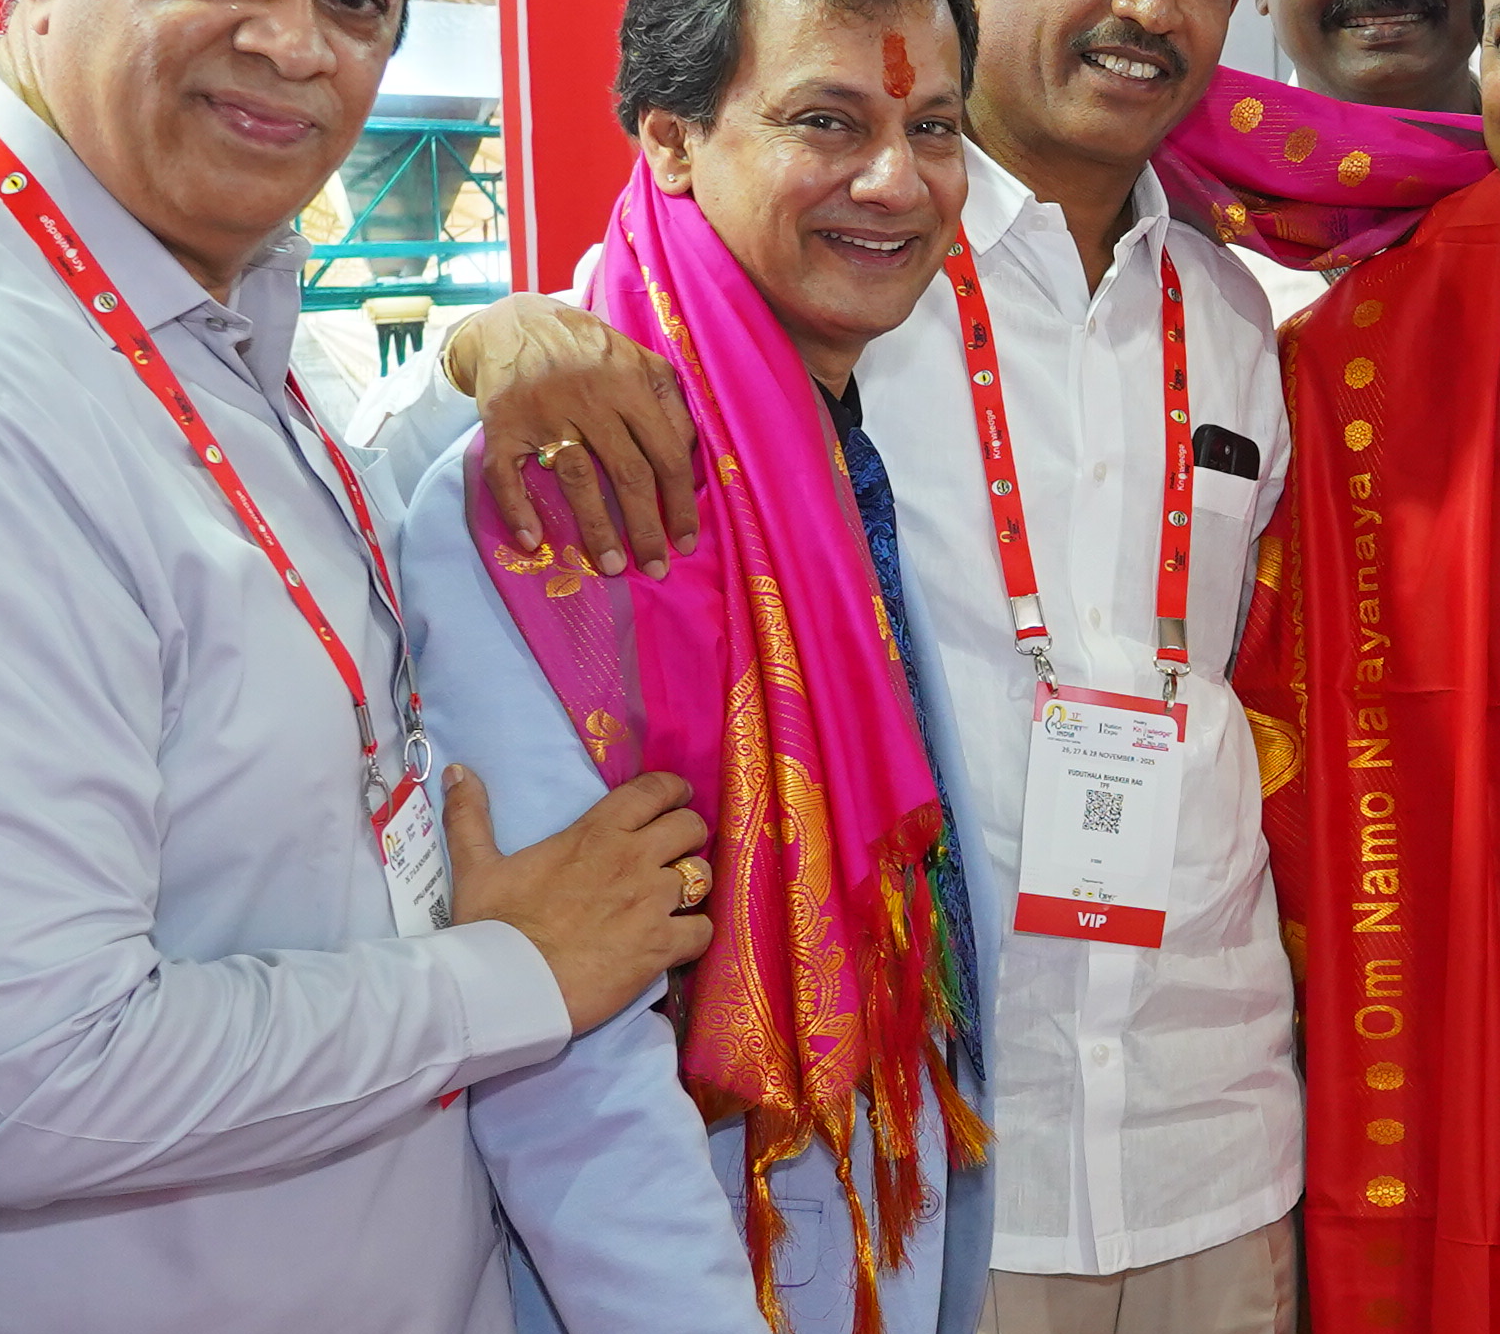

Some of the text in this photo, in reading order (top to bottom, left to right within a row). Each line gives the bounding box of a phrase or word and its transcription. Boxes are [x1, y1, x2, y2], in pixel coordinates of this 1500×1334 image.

[1347, 470, 1404, 1043] Om Namo Narayanaya
[1077, 911, 1107, 928] VIP
